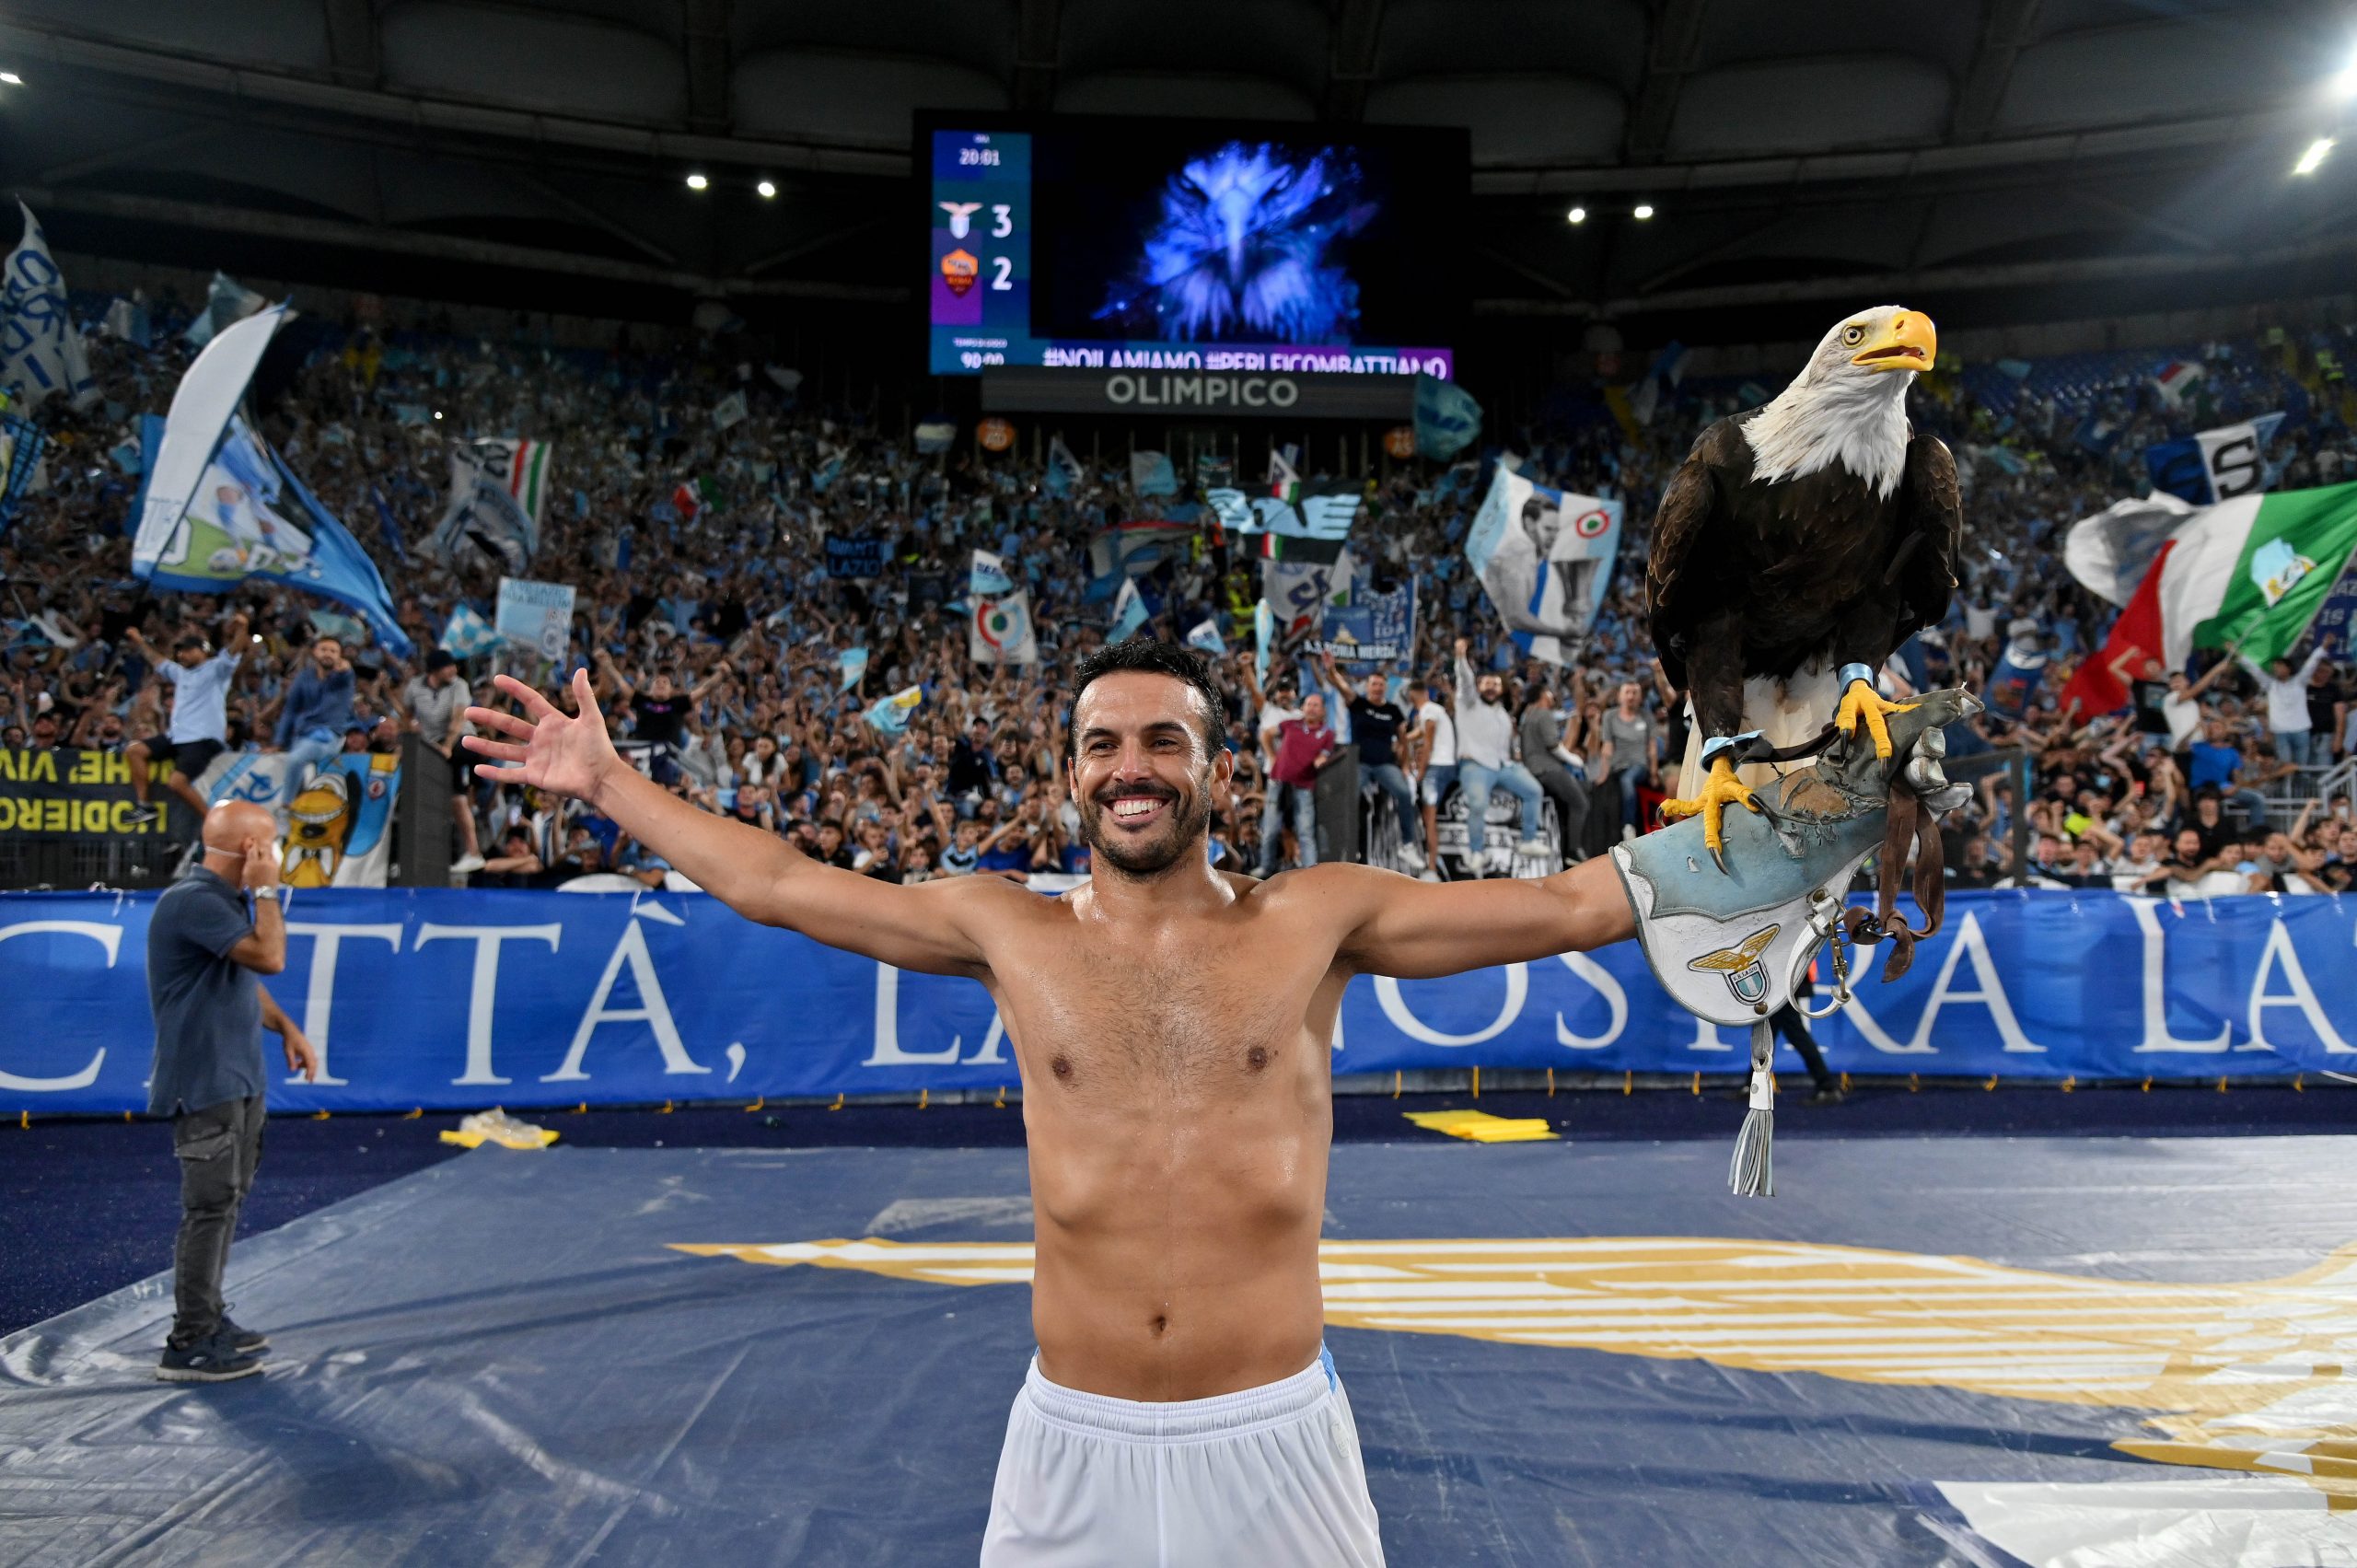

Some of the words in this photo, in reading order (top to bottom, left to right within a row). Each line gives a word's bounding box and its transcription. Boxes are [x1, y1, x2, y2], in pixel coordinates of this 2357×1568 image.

[992, 204, 1013, 238] 3
[992, 256, 1013, 290] 2
[1106, 374, 1299, 407] OLIMPICO
[0, 899, 746, 1092] CTTÀ,
[860, 960, 1008, 1067] L
[1332, 910, 2048, 1054] OSRA
